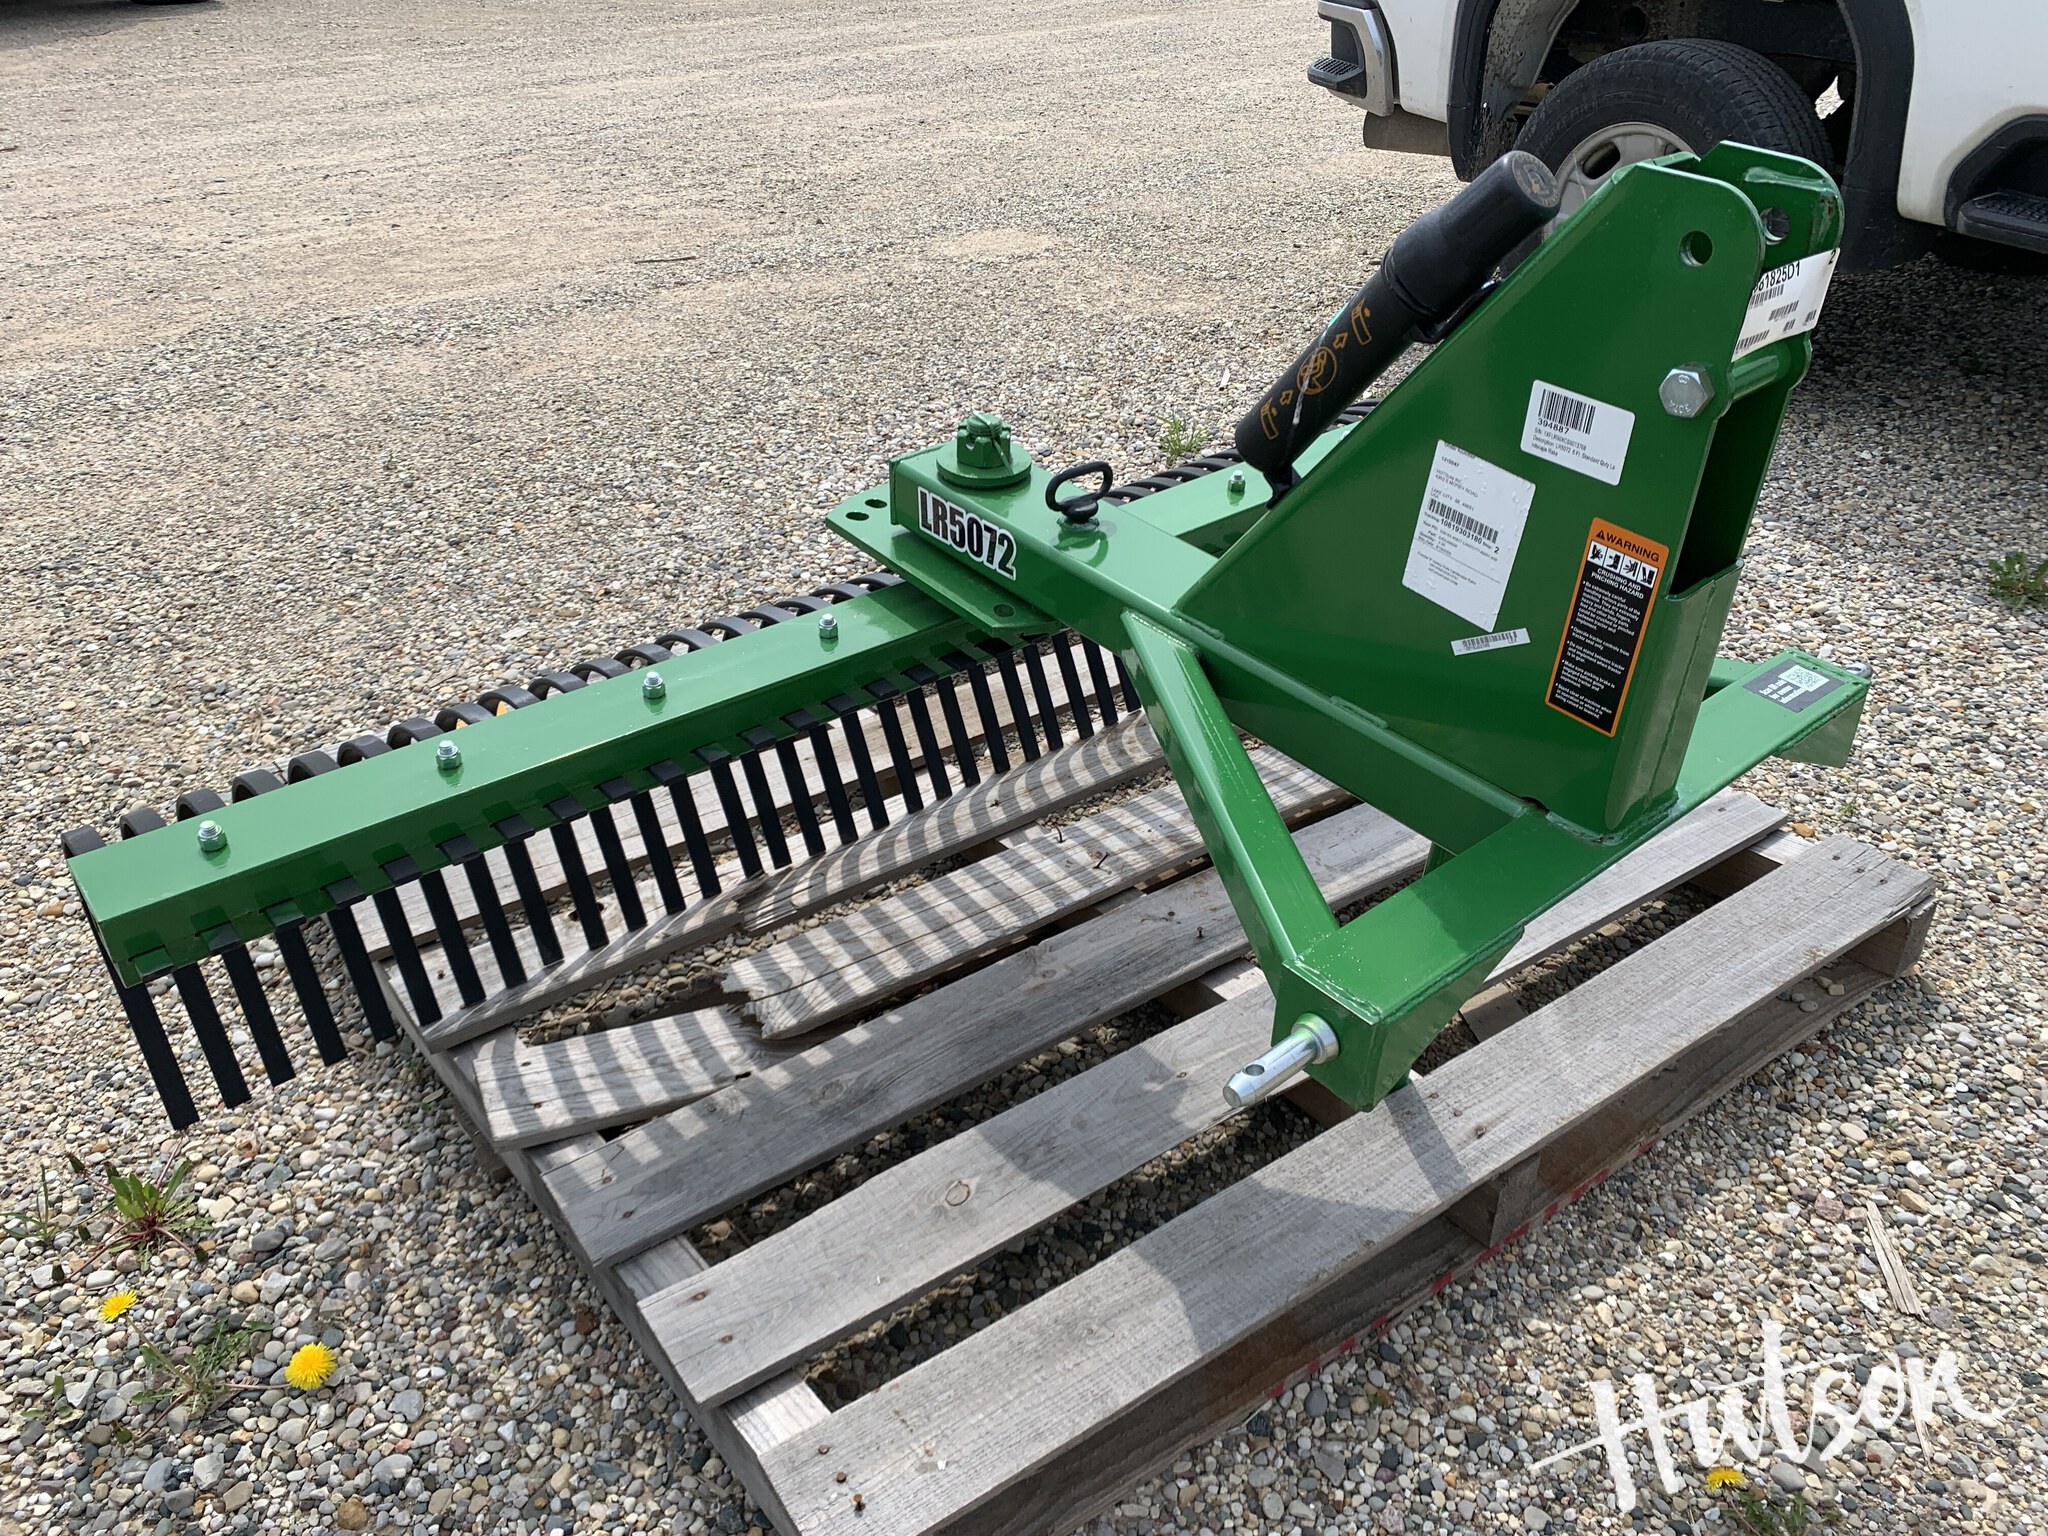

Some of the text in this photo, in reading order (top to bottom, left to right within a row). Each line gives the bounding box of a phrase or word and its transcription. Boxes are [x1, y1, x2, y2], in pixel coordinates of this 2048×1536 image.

[1828, 249, 1837, 266] 2
[1537, 417, 1569, 435] 394887
[919, 490, 1015, 580] LR5072
[1493, 545, 1500, 554] 2
[1605, 532, 1660, 562] WARNING
[1590, 571, 1644, 599] PINCHING HAZARD
[1597, 567, 1641, 591] CRUSHING AND
[1591, 584, 1611, 596] extremely
[1611, 593, 1626, 603] careful
[1601, 600, 1611, 608] They
[1618, 608, 1639, 621] extremely
[1616, 601, 1628, 610] parts
[1587, 605, 1596, 613] and
[1617, 619, 1628, 628] parts
